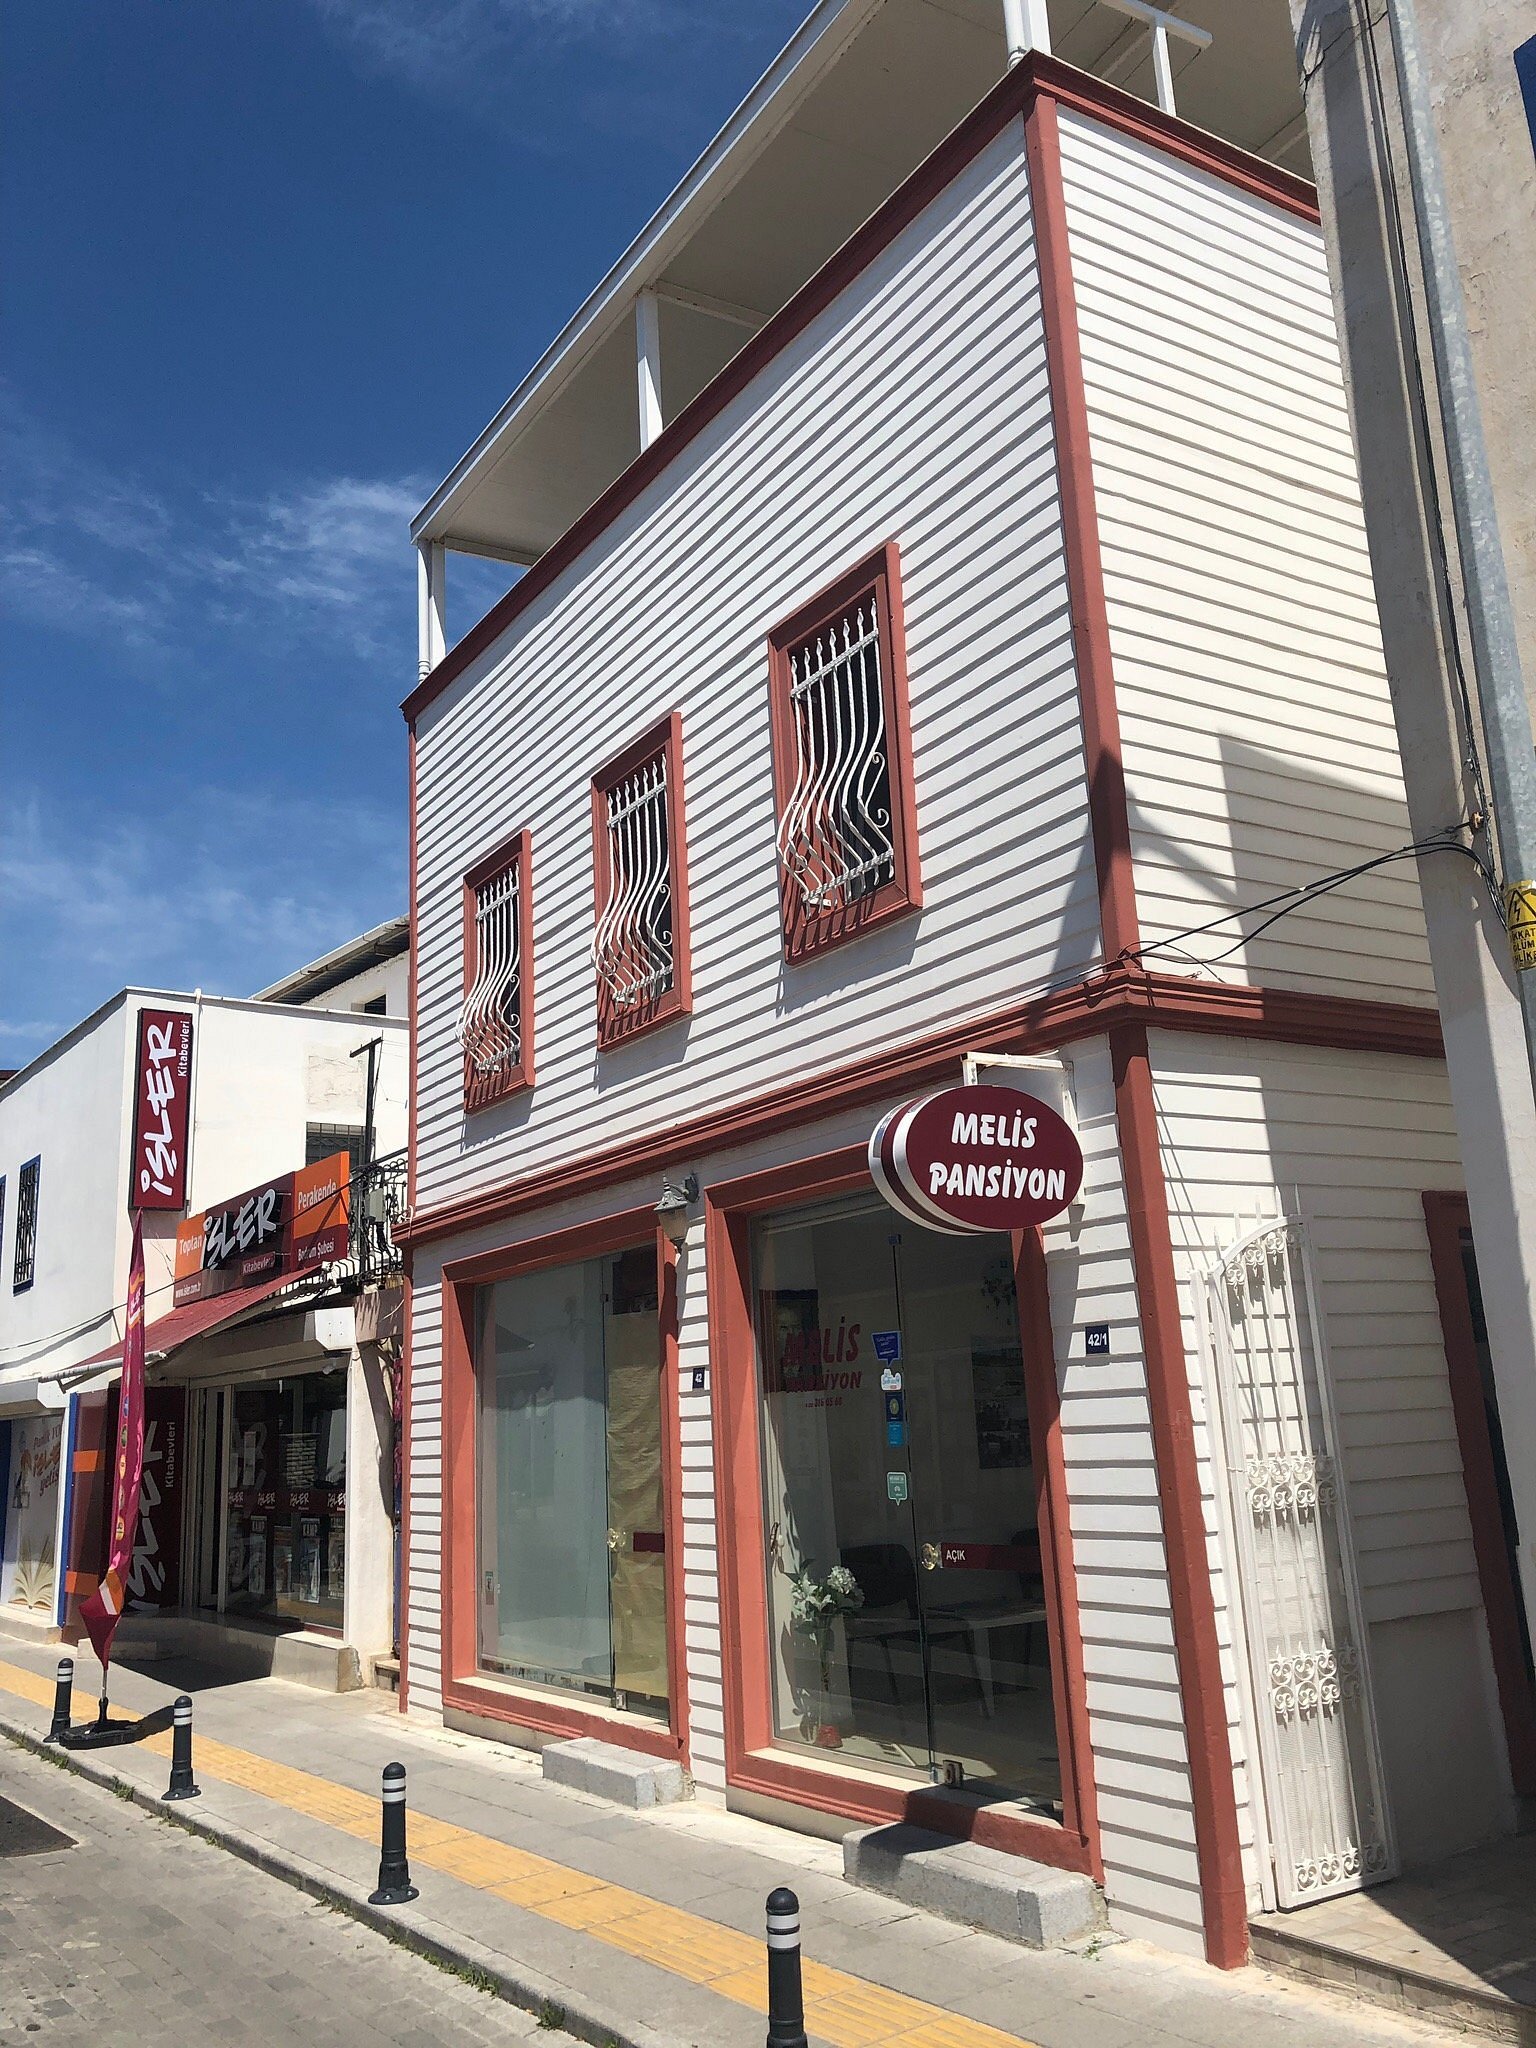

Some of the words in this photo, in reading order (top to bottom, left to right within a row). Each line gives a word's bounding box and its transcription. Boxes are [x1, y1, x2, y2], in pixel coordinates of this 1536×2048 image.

[177, 1020, 191, 1078] Kitabevleri
[140, 1021, 177, 1196] İŞLER
[951, 1109, 1038, 1149] MELİS
[298, 1179, 337, 1210] Perakende
[929, 1158, 1066, 1200] PANSİYON
[179, 1234, 202, 1256] Toptan
[200, 1188, 277, 1271] İŞLER
[1087, 1332, 1108, 1347] 42/1
[164, 1421, 176, 1488] Kitabevleri
[945, 1549, 966, 1563] AÇIK
